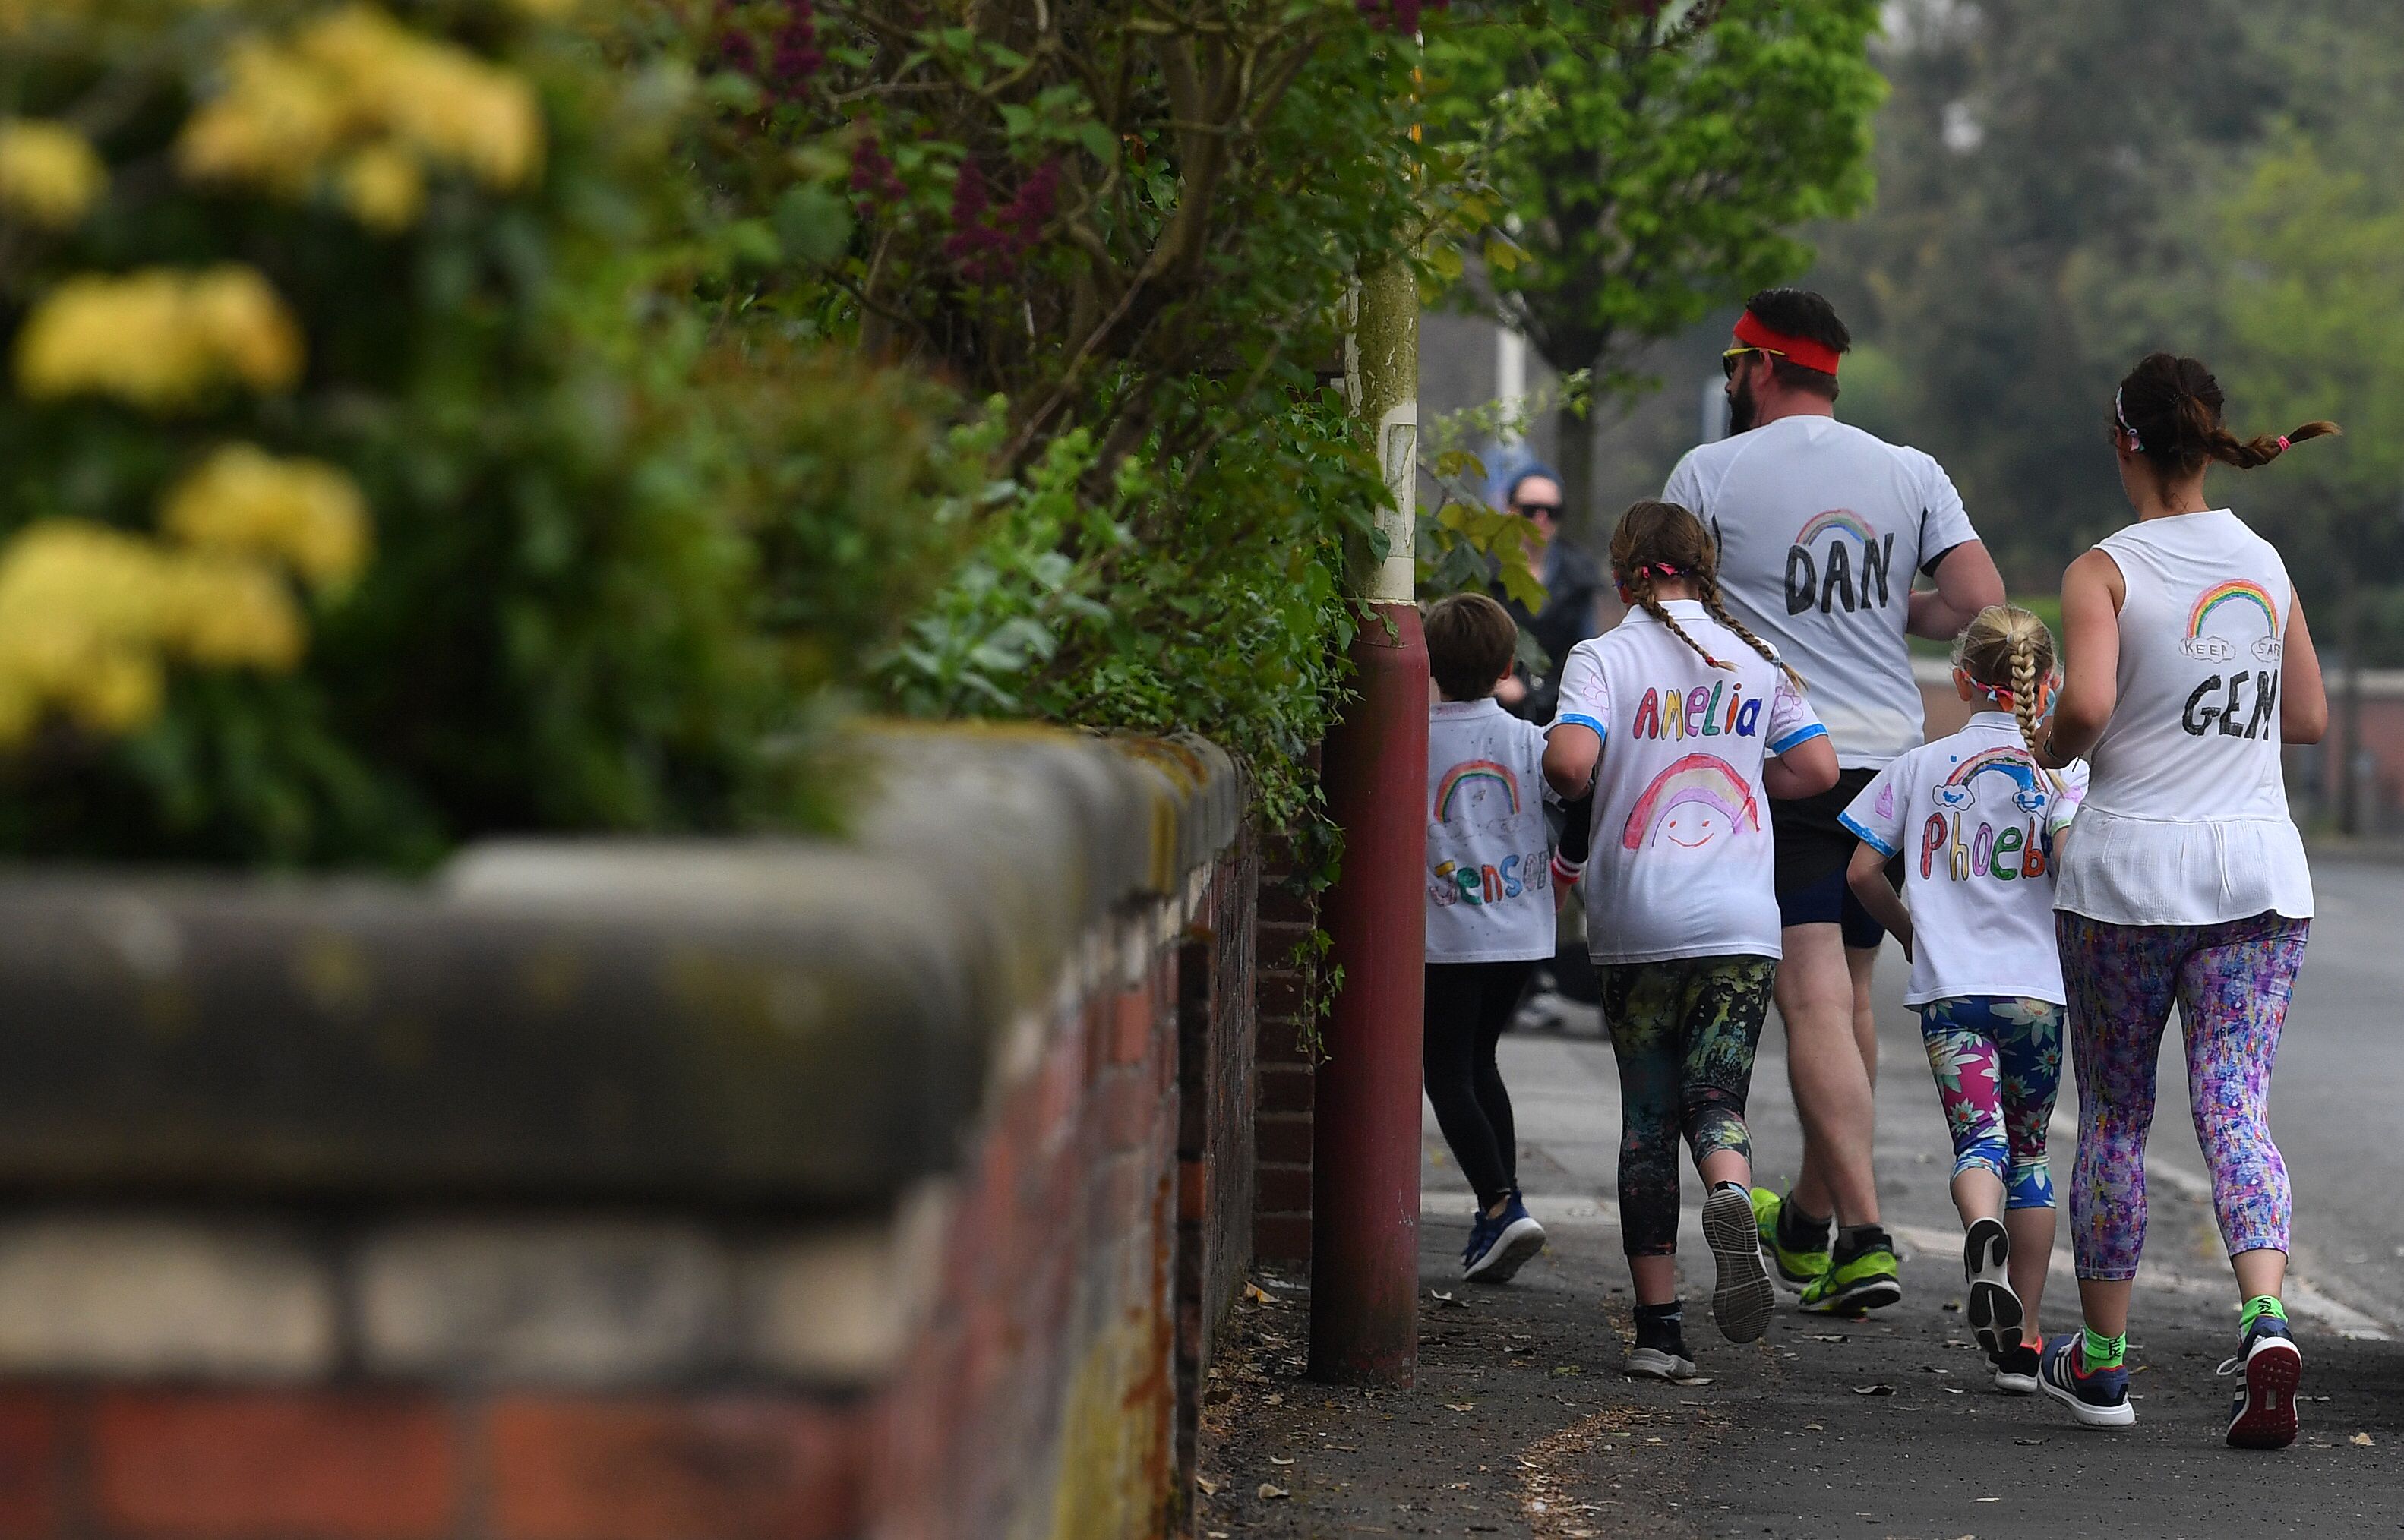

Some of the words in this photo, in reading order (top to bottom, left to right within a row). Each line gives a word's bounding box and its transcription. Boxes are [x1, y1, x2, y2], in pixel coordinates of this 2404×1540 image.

[1785, 532, 1894, 616] DAN
[2184, 640, 2227, 657] KEEP
[2256, 643, 2281, 656] SAF
[2182, 669, 2277, 741] GEM
[1920, 811, 2052, 881] Phoeb
